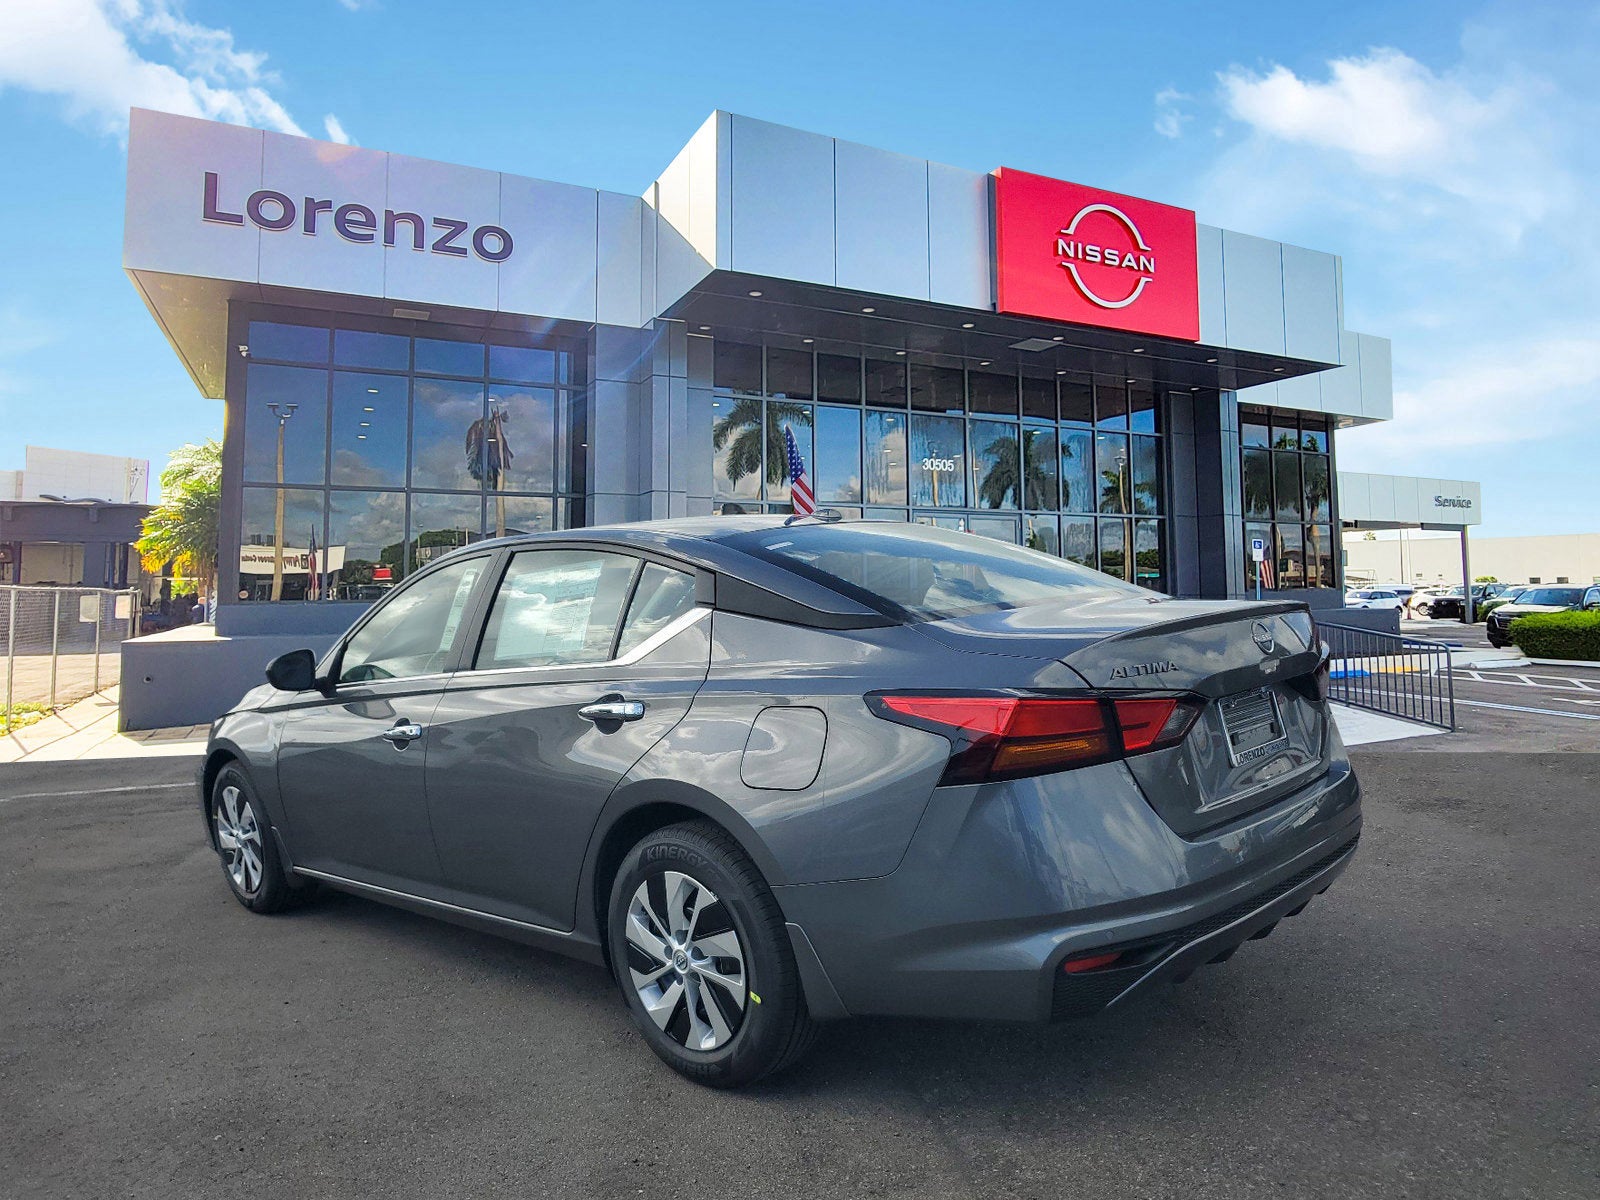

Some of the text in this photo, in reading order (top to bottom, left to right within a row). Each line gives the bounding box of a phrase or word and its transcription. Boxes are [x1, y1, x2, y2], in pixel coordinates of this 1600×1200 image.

[202, 170, 514, 263] Lorenzo
[1057, 238, 1155, 273] NISSAN
[922, 458, 955, 471] 30505
[1434, 495, 1472, 508] Service
[1109, 660, 1180, 680] ALTIMA
[1235, 747, 1266, 765] LORENZO
[647, 845, 707, 865] KINERGY
